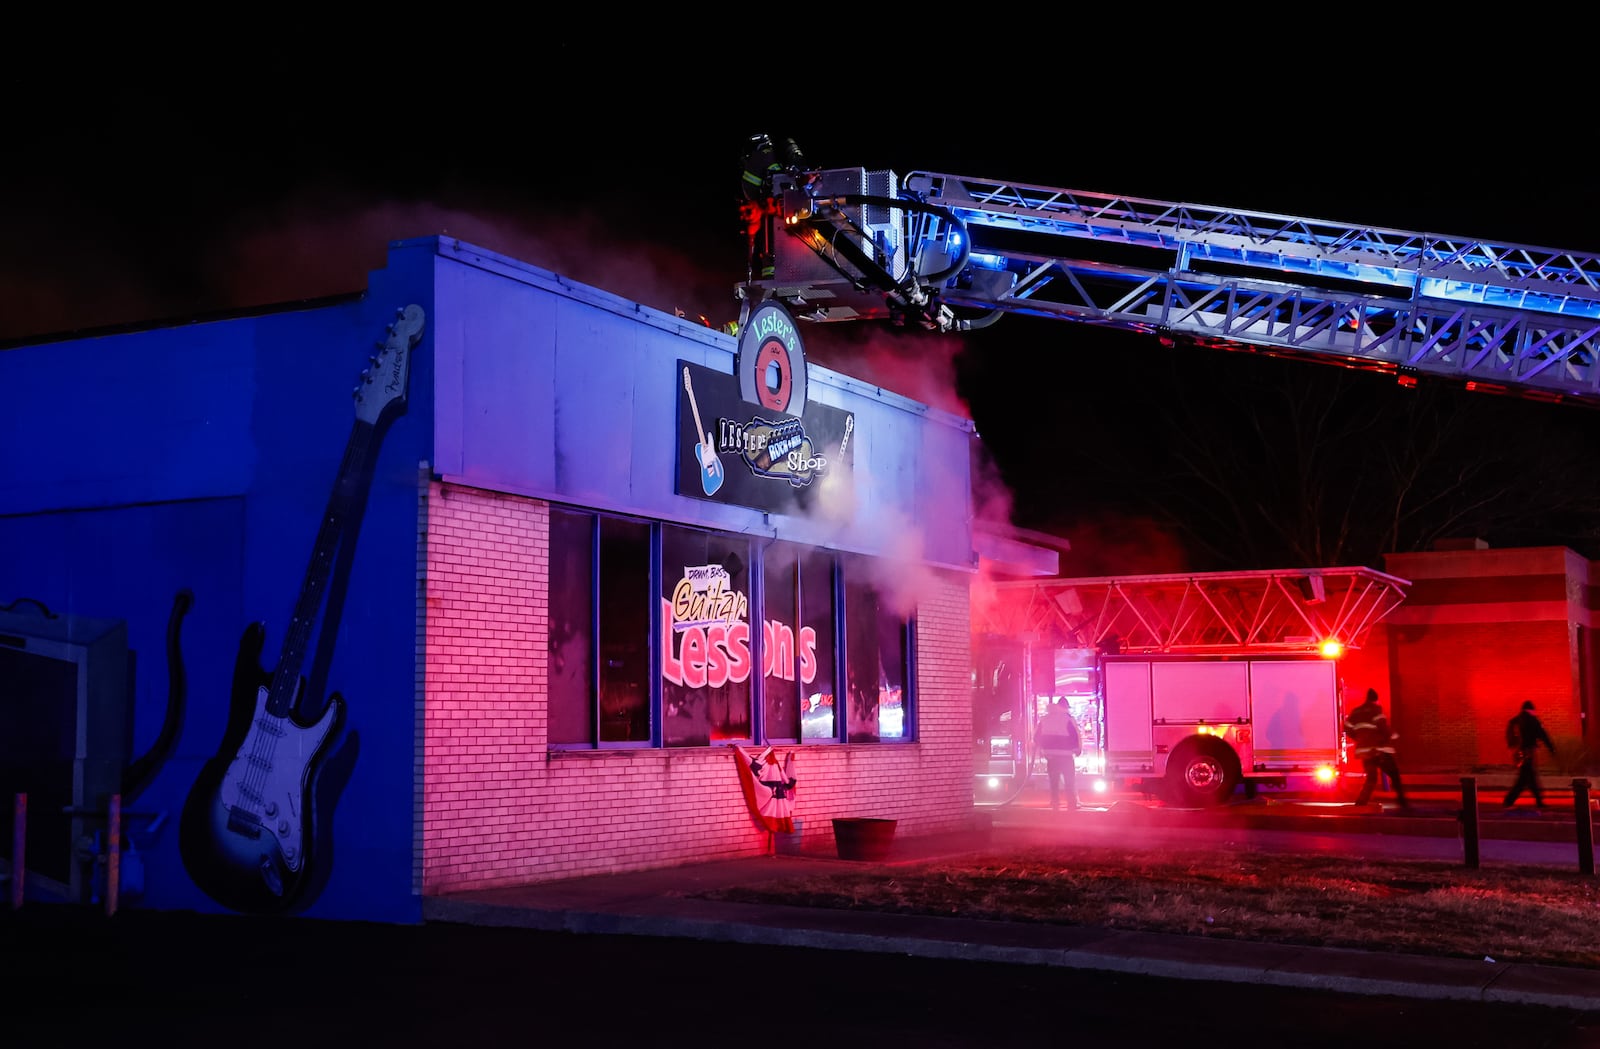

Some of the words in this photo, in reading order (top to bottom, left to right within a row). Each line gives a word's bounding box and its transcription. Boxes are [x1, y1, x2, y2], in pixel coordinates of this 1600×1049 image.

[752, 311, 796, 352] Lester's
[384, 351, 402, 393] Fender
[673, 579, 747, 623] Guitar
